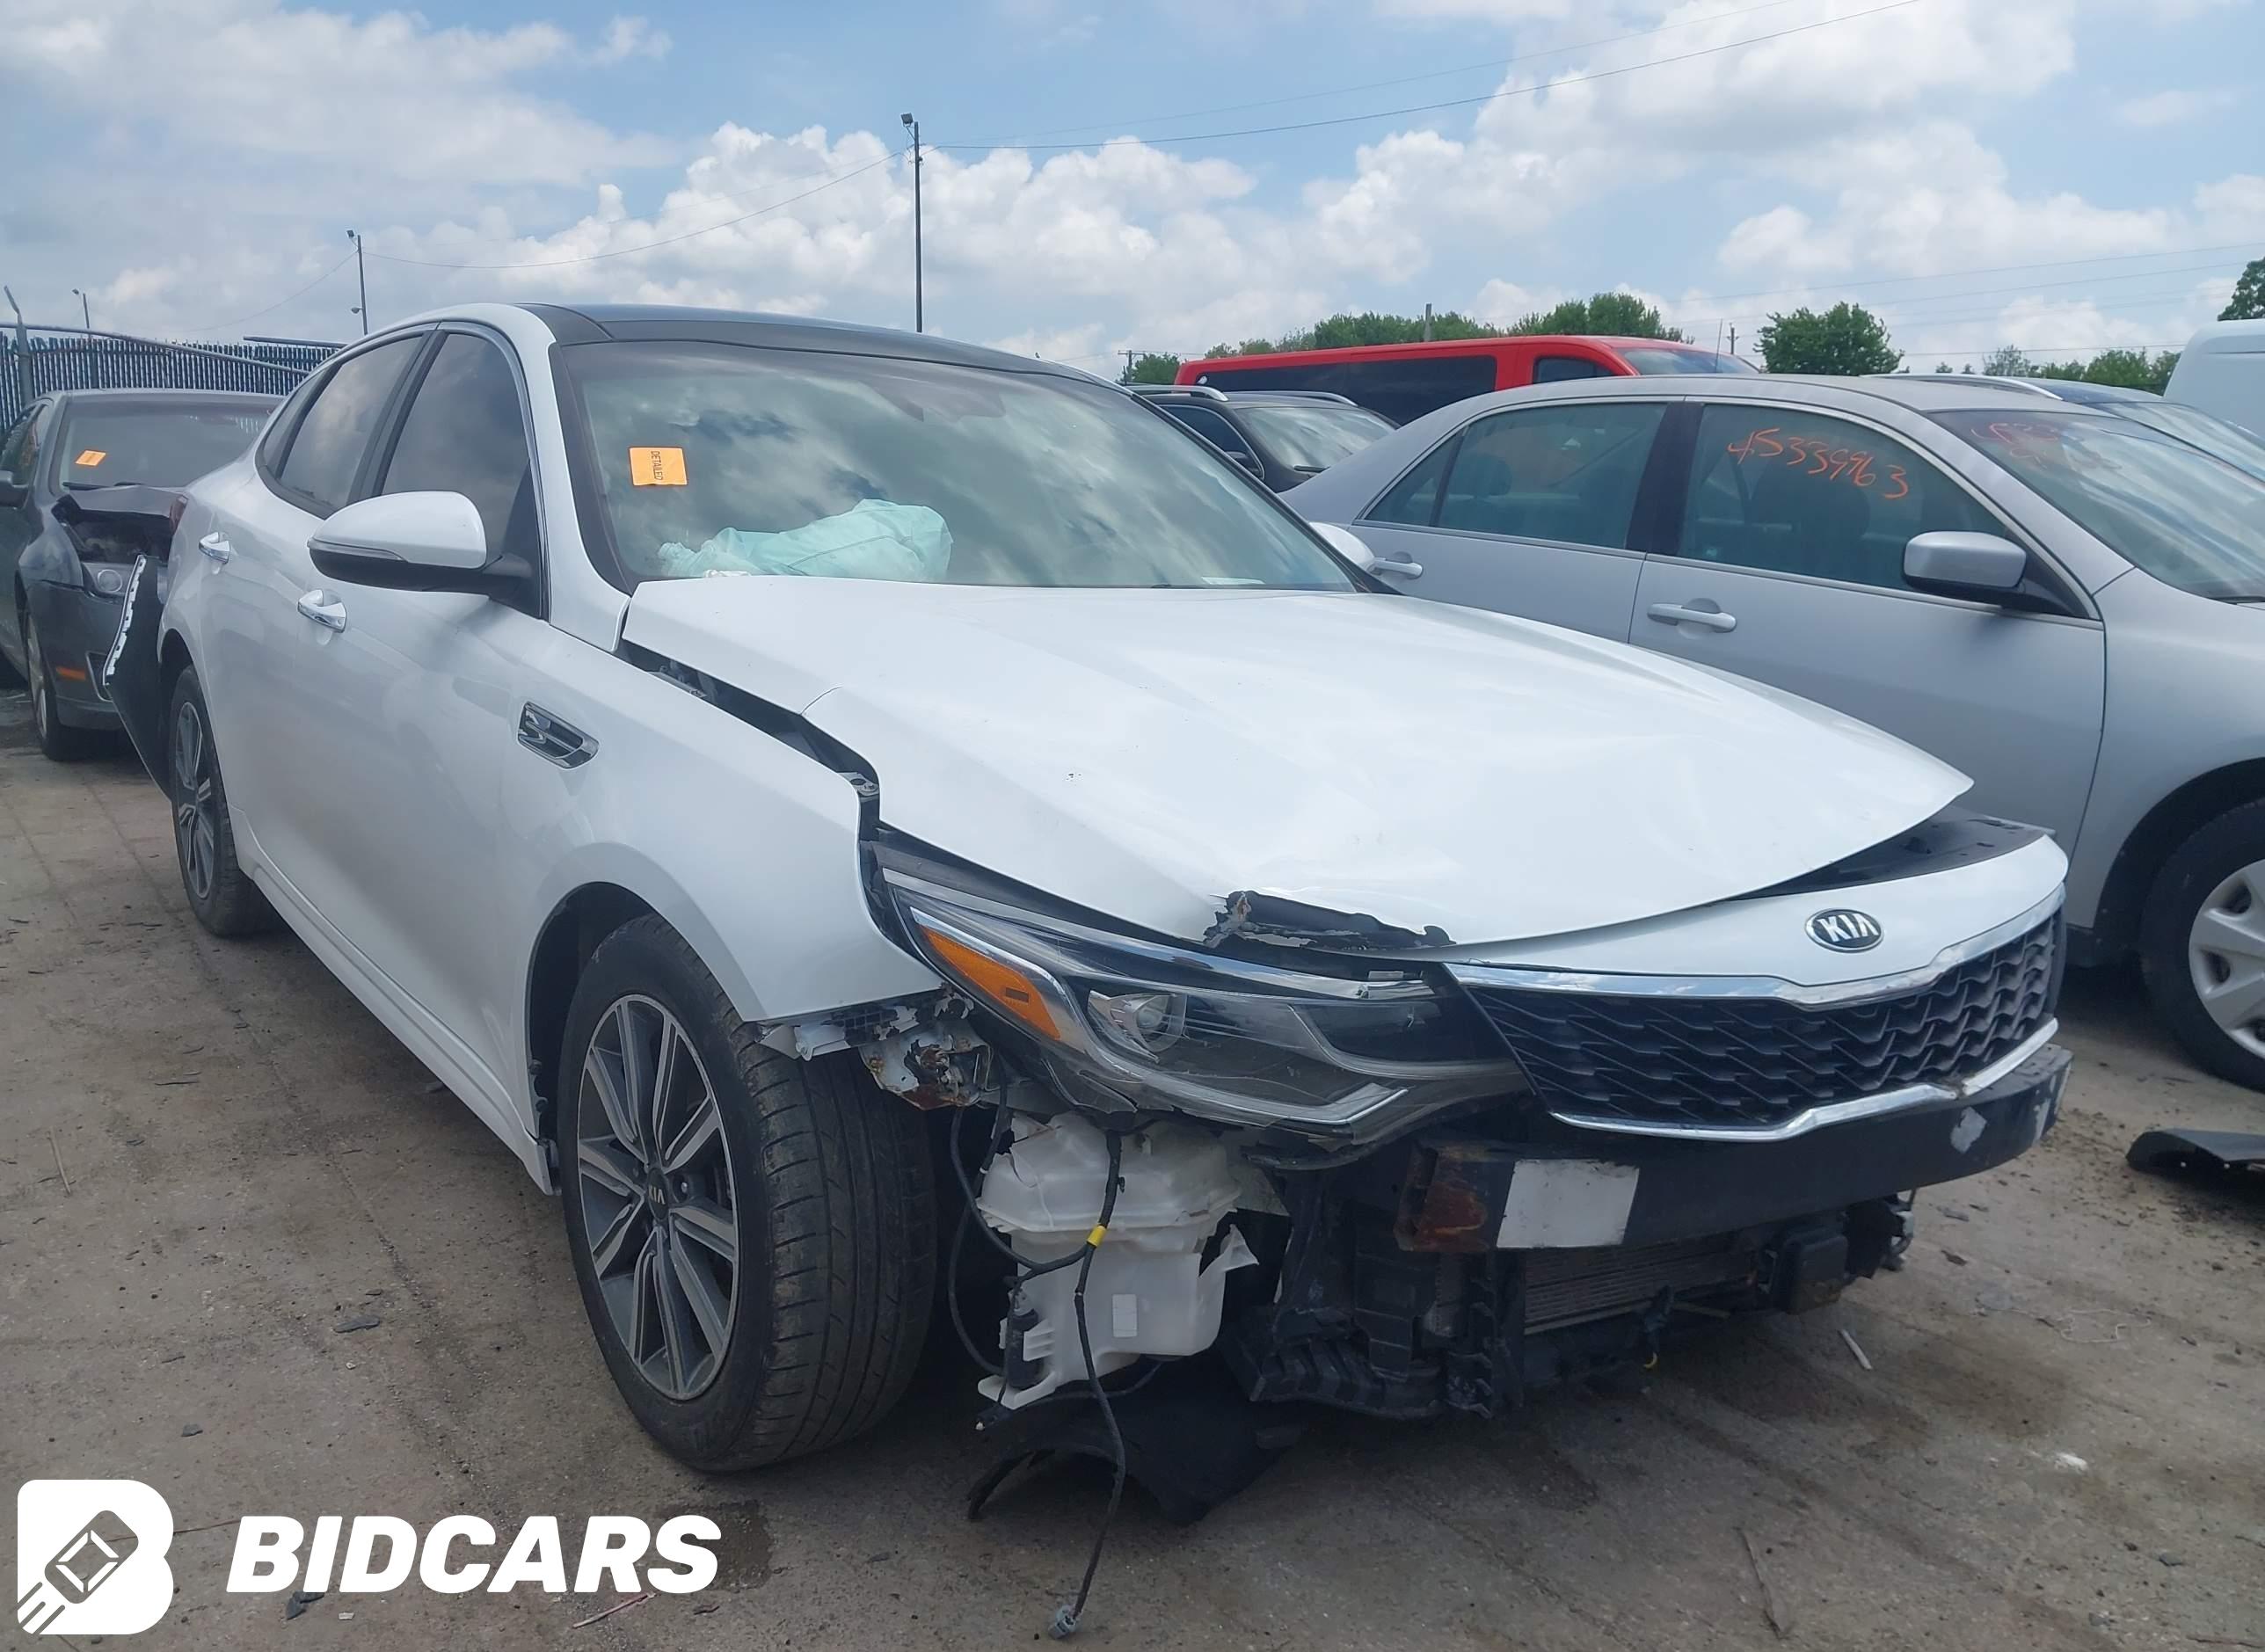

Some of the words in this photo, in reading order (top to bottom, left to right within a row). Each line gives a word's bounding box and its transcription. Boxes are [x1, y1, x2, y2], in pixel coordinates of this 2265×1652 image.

[1726, 427, 1909, 499] 45339963
[1817, 913, 1880, 943] KIA
[648, 1184, 666, 1205] KIA
